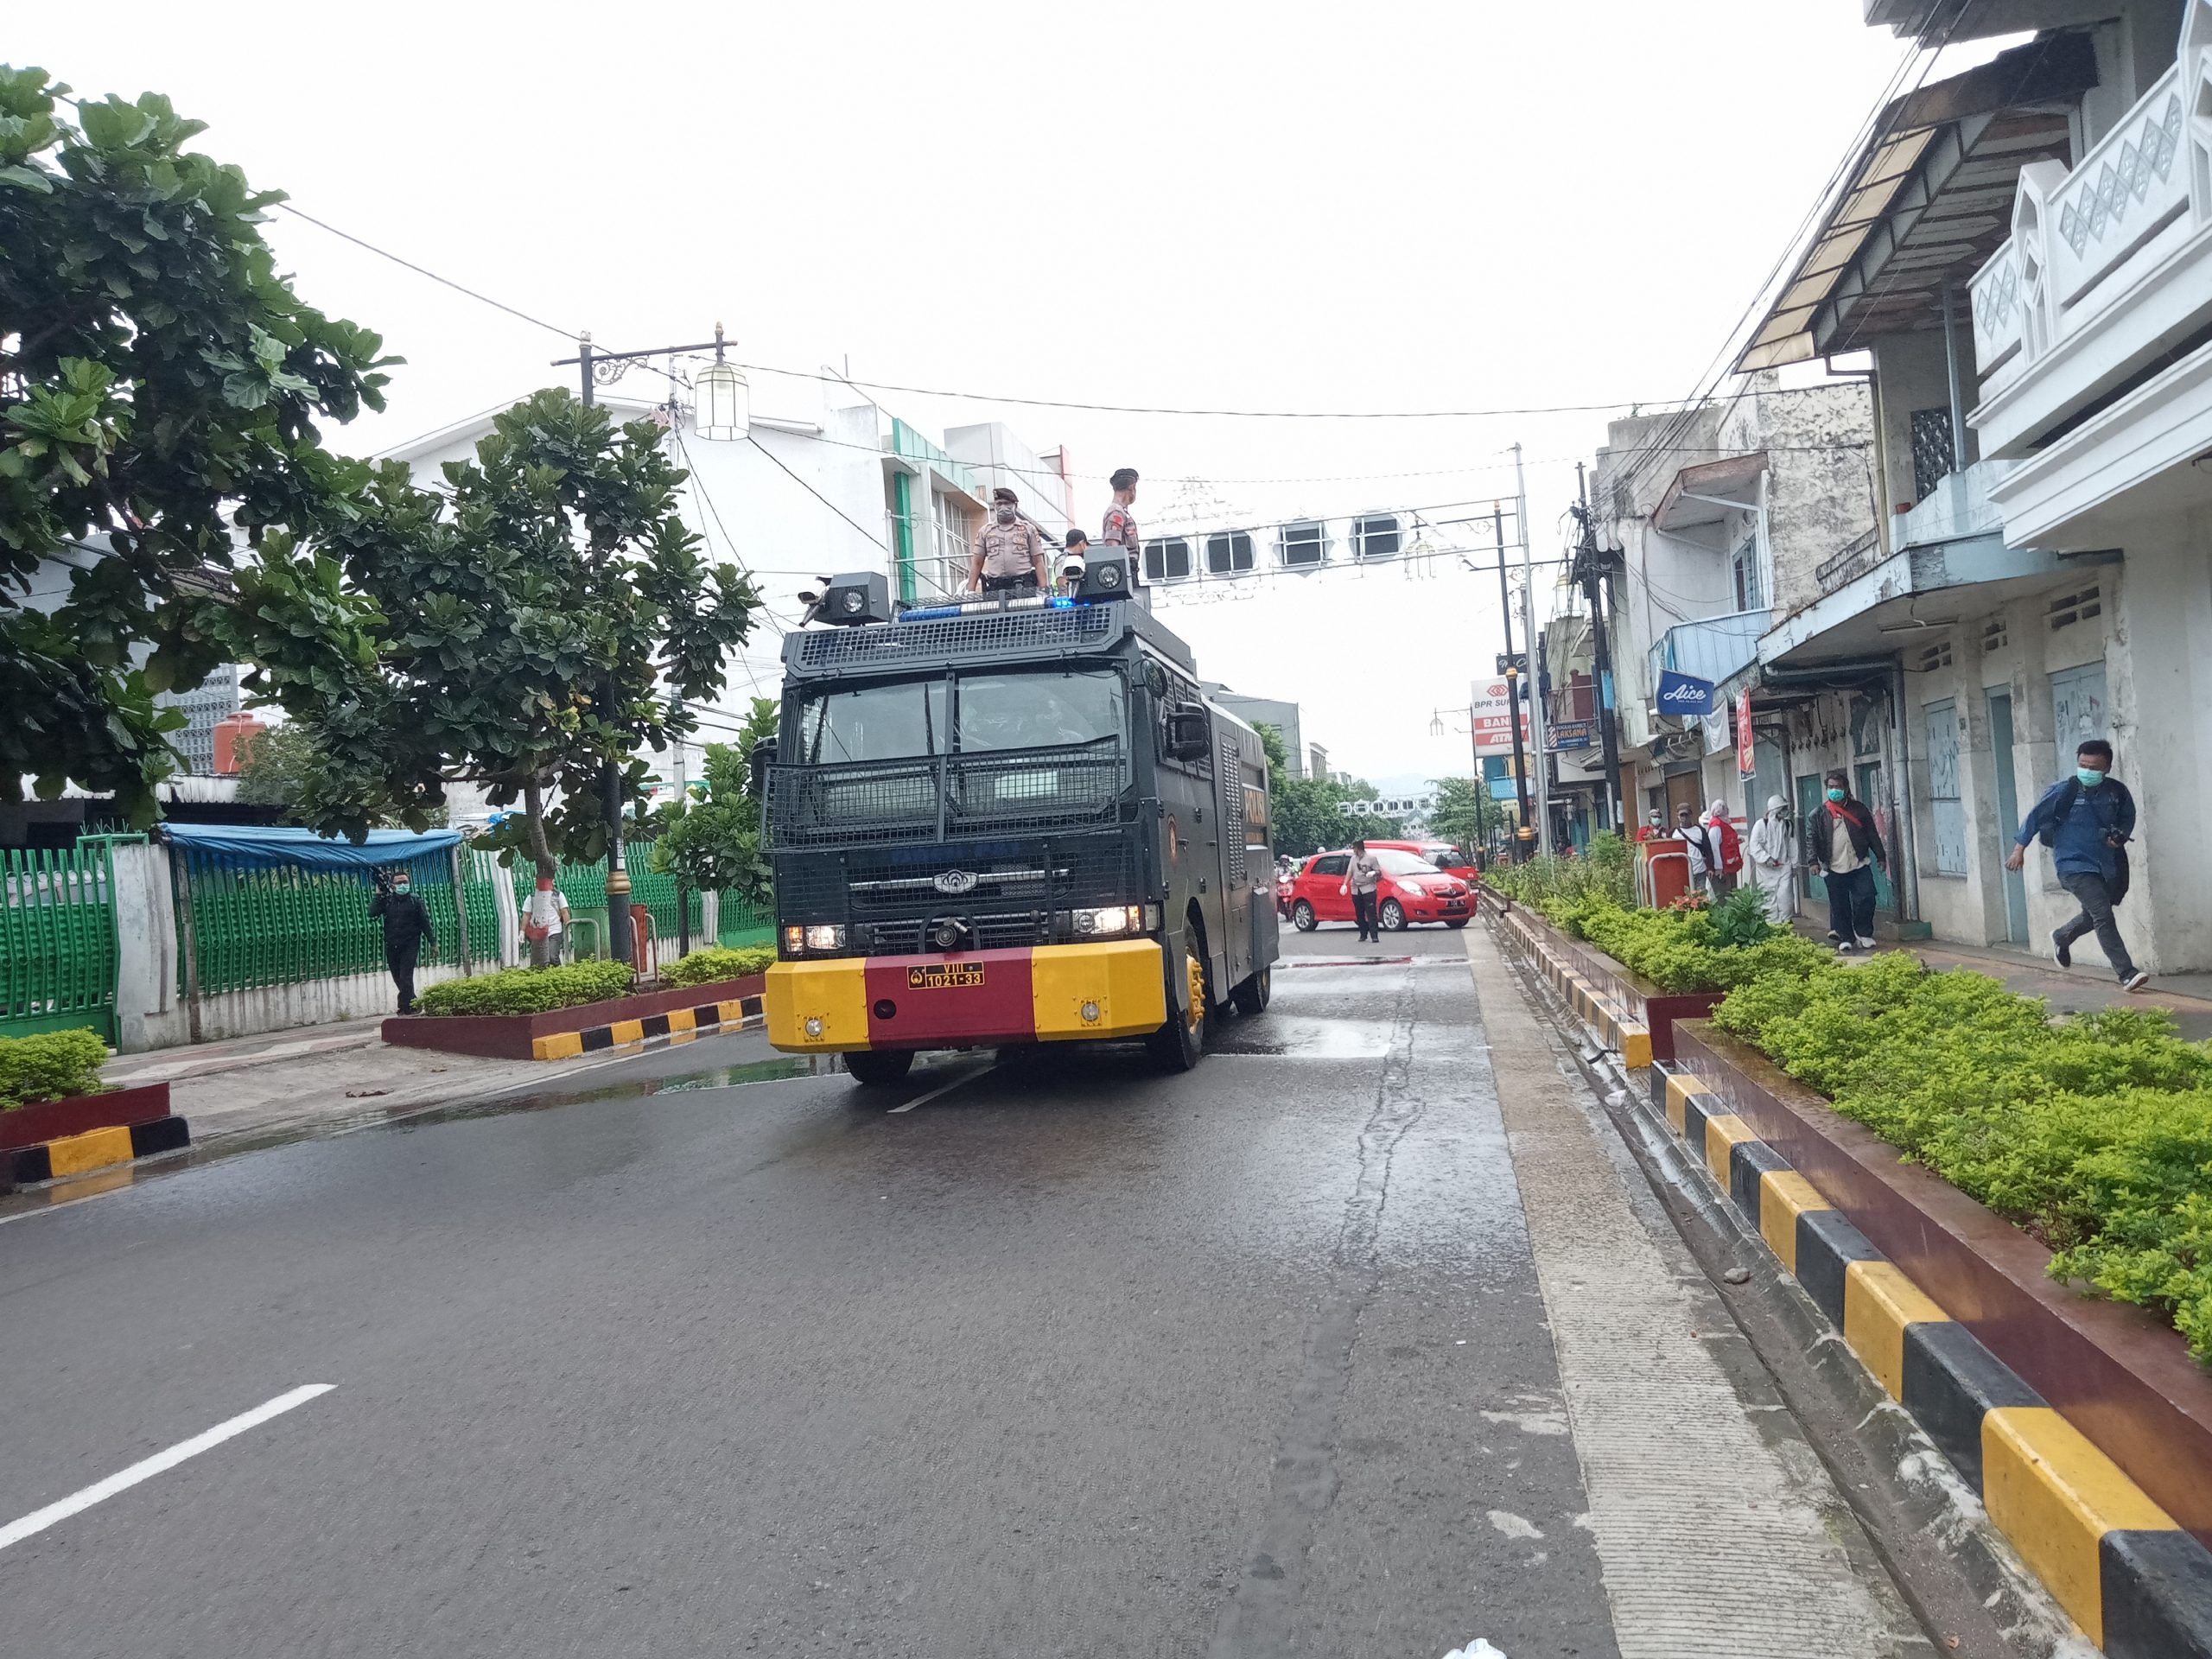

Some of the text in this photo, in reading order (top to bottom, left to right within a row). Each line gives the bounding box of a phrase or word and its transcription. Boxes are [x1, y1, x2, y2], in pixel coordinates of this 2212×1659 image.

[1663, 683, 1707, 700] Aice
[1483, 716, 1512, 728] BAN
[1557, 728, 1587, 740] LAKSANA
[944, 963, 963, 973] VIII
[928, 973, 982, 987] 1021-33
